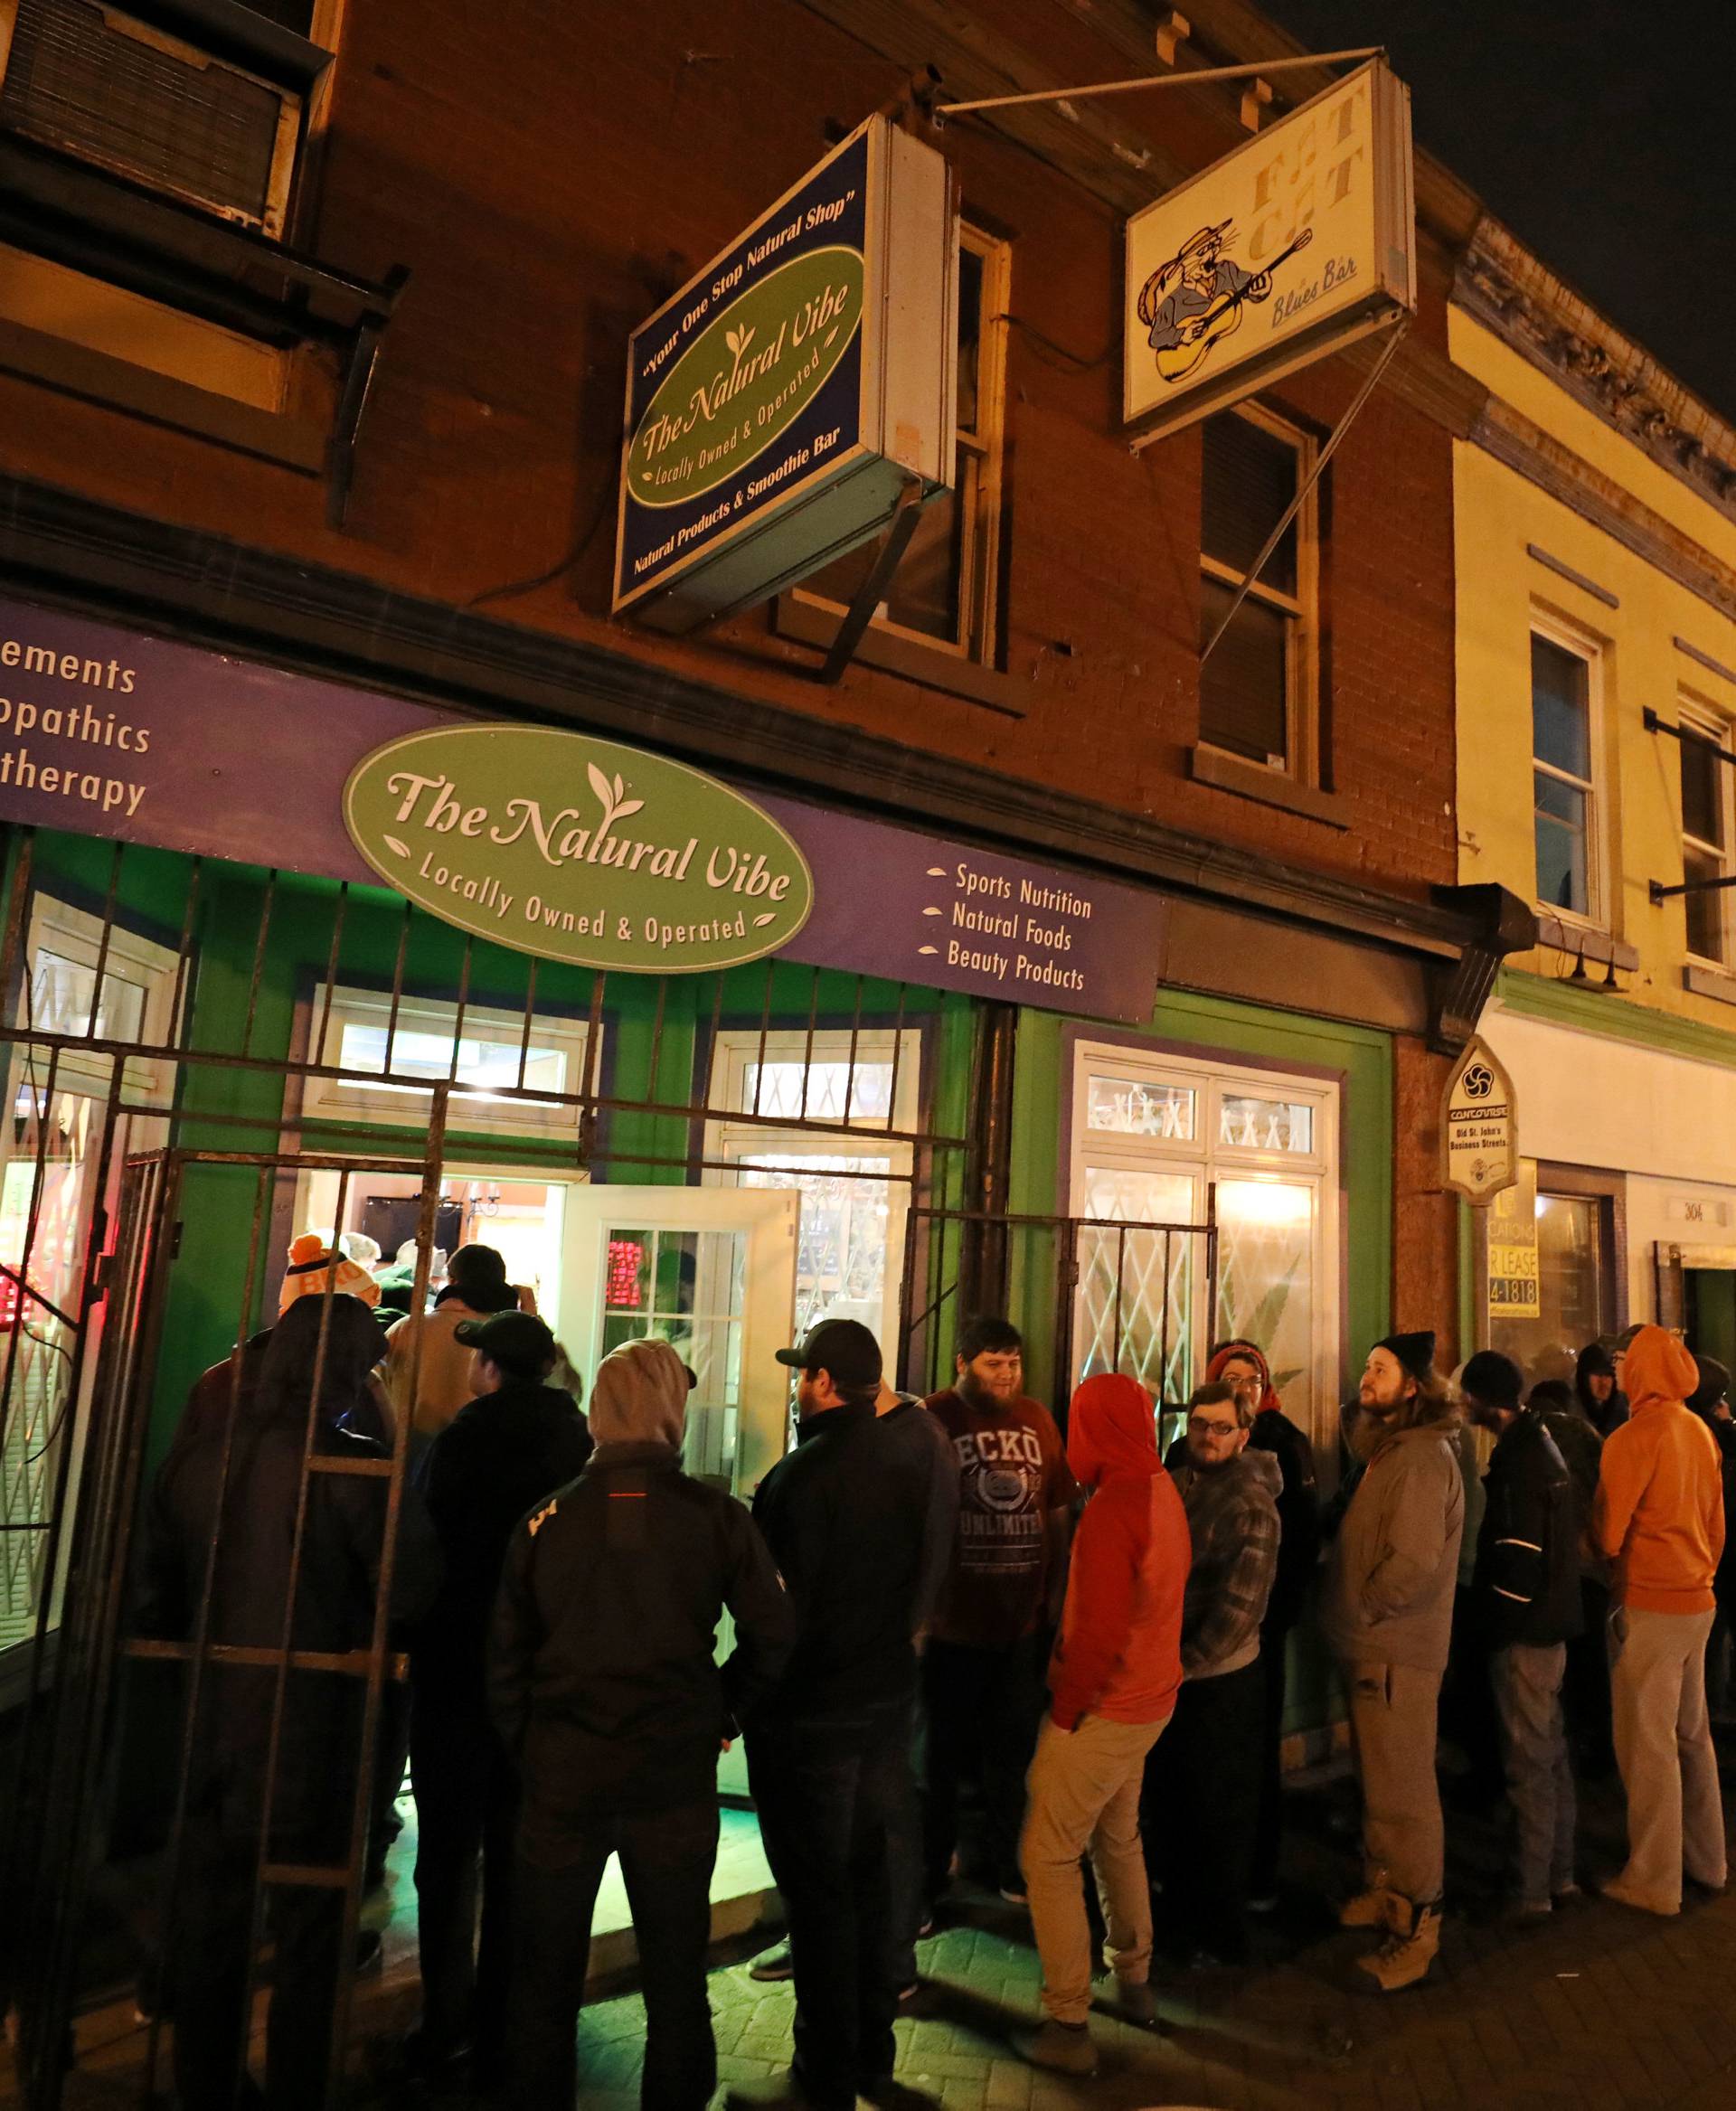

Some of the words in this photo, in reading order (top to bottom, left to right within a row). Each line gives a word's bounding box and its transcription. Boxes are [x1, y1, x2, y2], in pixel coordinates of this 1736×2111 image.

[682, 298, 709, 333] One
[712, 264, 743, 302] Stop
[747, 216, 803, 270] Natural
[1272, 281, 1317, 329] Blues
[1323, 258, 1357, 290] Bar
[643, 414, 683, 461] The
[684, 321, 788, 434] Natural
[792, 284, 848, 347] Vibe
[656, 456, 695, 485] Locally
[699, 427, 738, 469] Owned
[742, 420, 751, 439] &
[758, 347, 819, 426] Operated
[634, 536, 675, 574] Natural
[677, 501, 731, 548] Products
[733, 491, 744, 509] &
[746, 449, 810, 501] Smoothie
[814, 427, 841, 457] Bar
[1, 639, 137, 694] ements
[1, 749, 146, 816] therapy
[388, 772, 489, 836] The
[490, 762, 699, 881] Natural
[706, 845, 791, 902] Vibe
[419, 852, 514, 918] Locally
[524, 895, 605, 938] Owned
[617, 918, 634, 941] &
[645, 911, 747, 949] Operated
[956, 863, 1012, 900] Sports
[1020, 879, 1092, 919] Nutrition
[952, 900, 1019, 939] Natural
[1025, 918, 1072, 951] Foods
[948, 939, 1009, 981] Beauty
[1015, 954, 1085, 991] Products
[1450, 1141, 1480, 1151] Business
[1457, 1127, 1467, 1138] Old
[1490, 1279, 1535, 1302] 4-1818
[1502, 1251, 1536, 1277] LEASE
